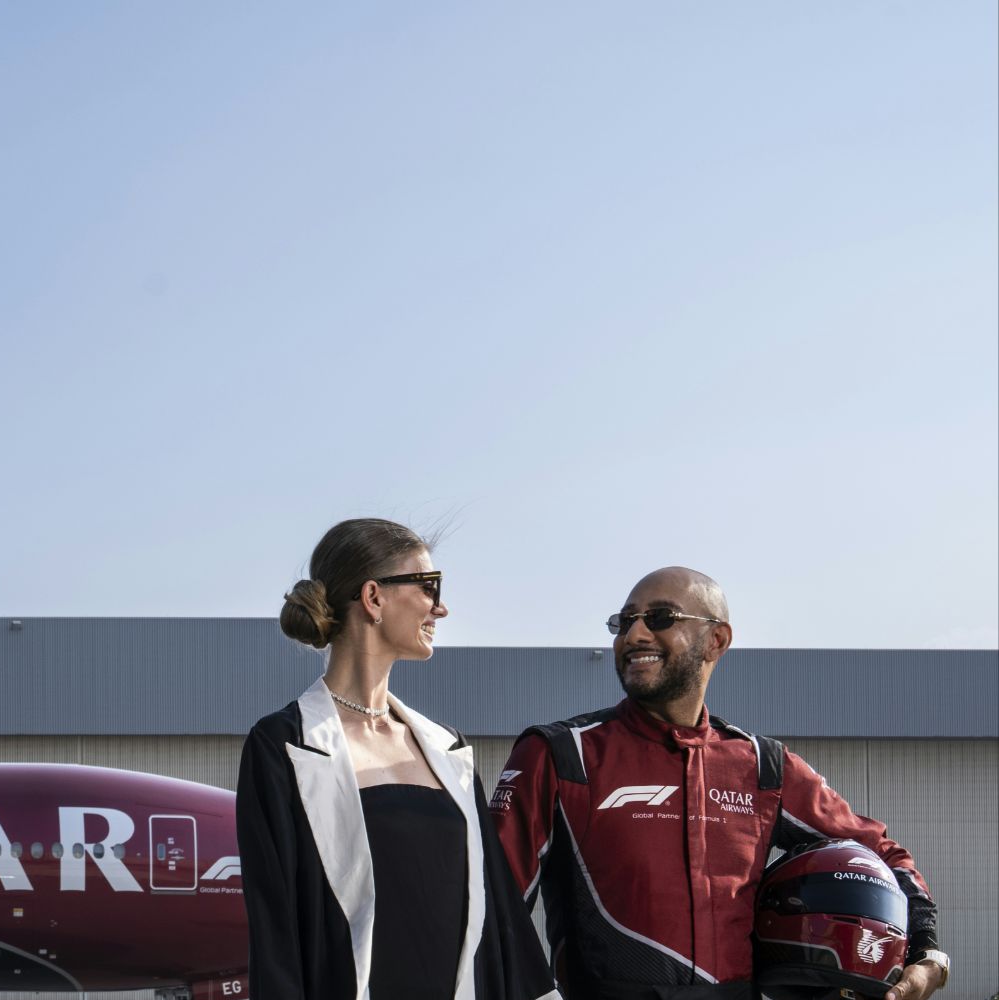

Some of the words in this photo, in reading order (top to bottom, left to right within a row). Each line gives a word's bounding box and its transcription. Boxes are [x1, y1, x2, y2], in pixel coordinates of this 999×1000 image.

[708, 788, 753, 806] QATAR
[720, 803, 755, 816] AIRWAYS
[833, 871, 867, 882] QATAR
[222, 980, 242, 996] EG
